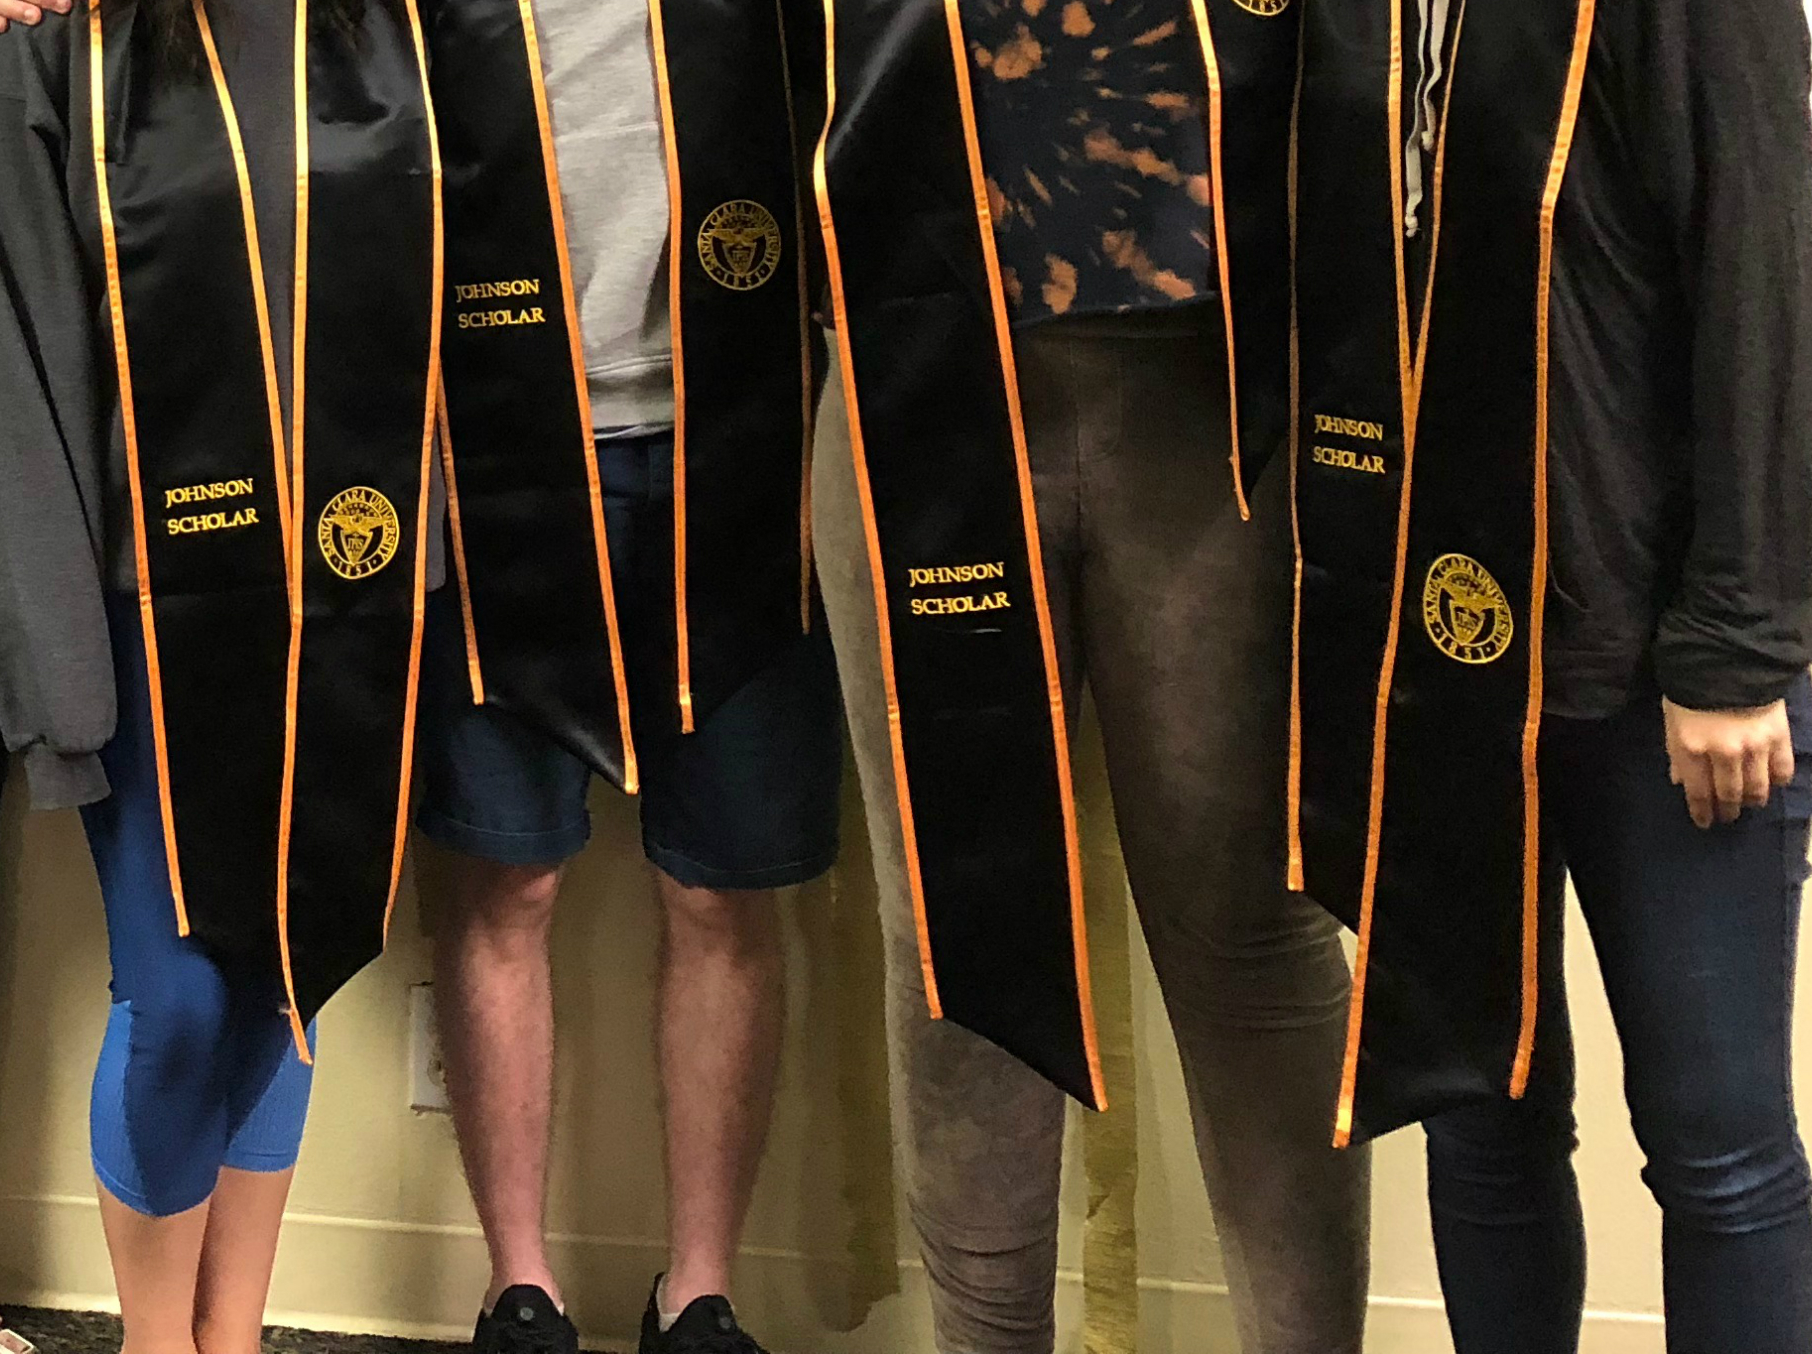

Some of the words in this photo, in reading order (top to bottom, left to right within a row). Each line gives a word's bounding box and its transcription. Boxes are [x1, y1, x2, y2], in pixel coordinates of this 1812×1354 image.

[454, 278, 540, 303] JOHNSON
[458, 307, 547, 329] SCHOLAR
[1314, 414, 1384, 441] JOHNSON
[1312, 445, 1386, 475] SCHOLAR
[164, 477, 254, 509] JOHNSON
[167, 507, 260, 535] SCHOLAR
[907, 561, 1005, 588] JOHNSON
[910, 591, 1012, 616] SCHOLAR
